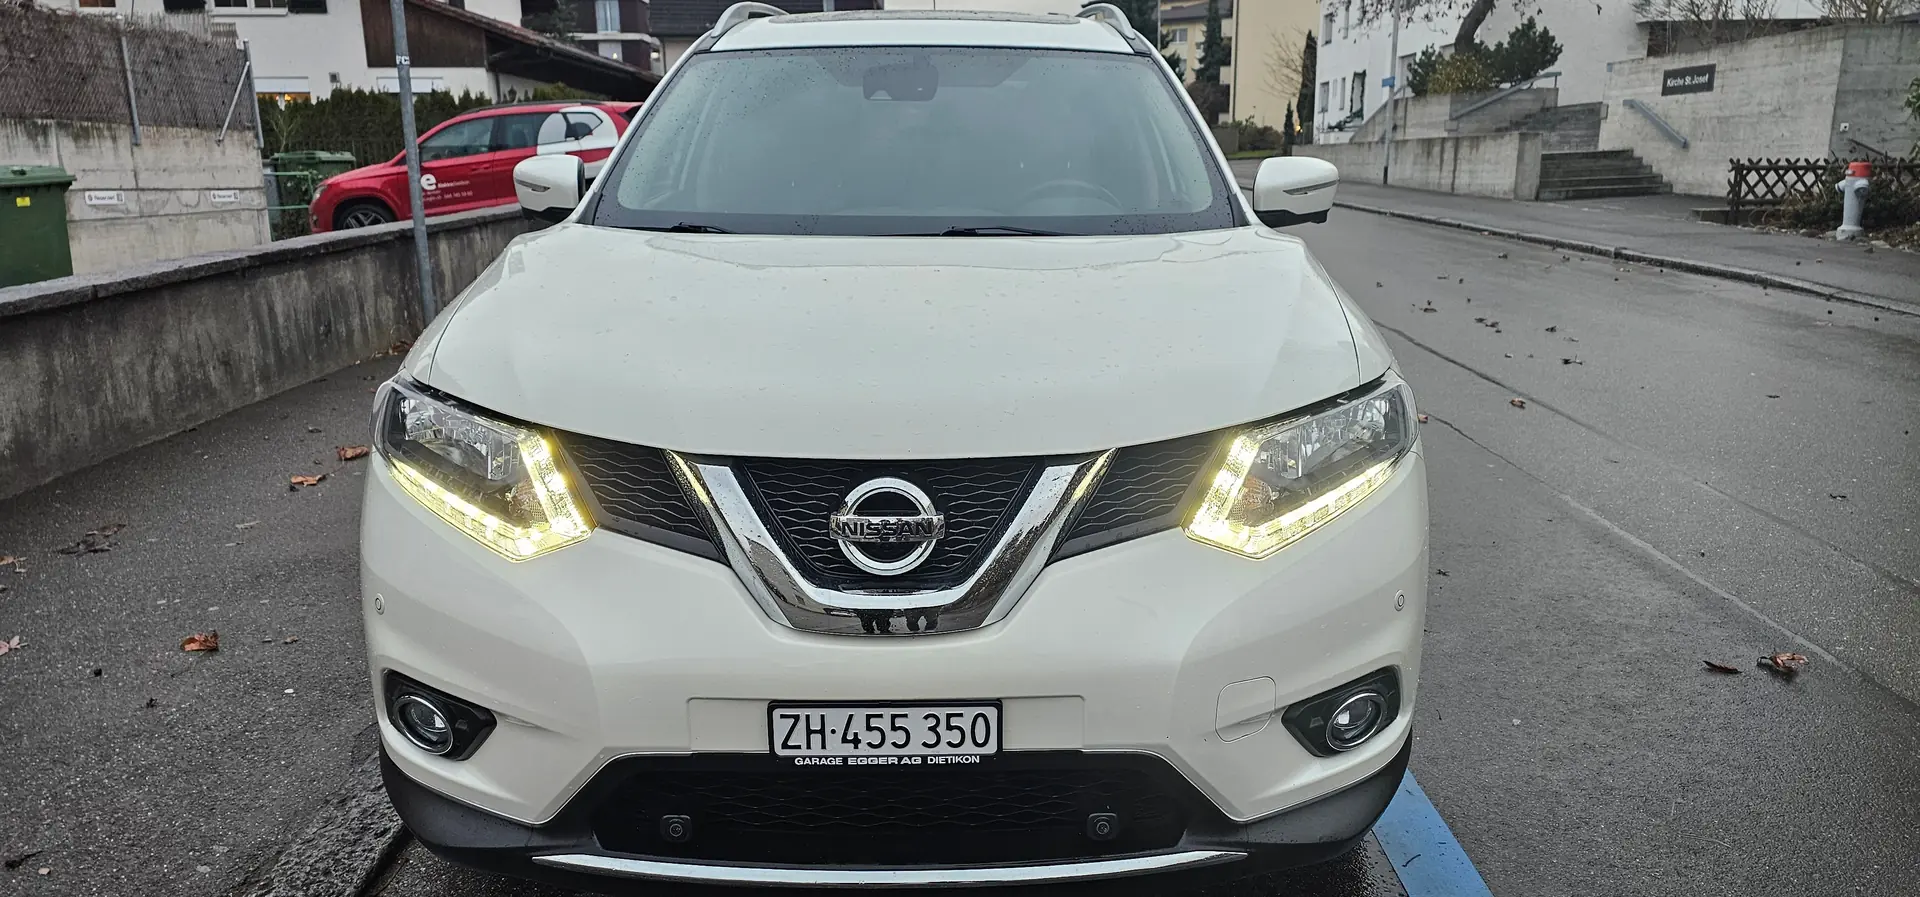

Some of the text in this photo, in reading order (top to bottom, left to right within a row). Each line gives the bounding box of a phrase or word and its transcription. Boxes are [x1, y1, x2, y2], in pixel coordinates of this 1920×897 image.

[420, 173, 437, 191] e
[841, 518, 935, 536] NISSAN
[921, 711, 991, 749] 350
[794, 755, 980, 766] GARAGE EGGER AG DIETIKON
